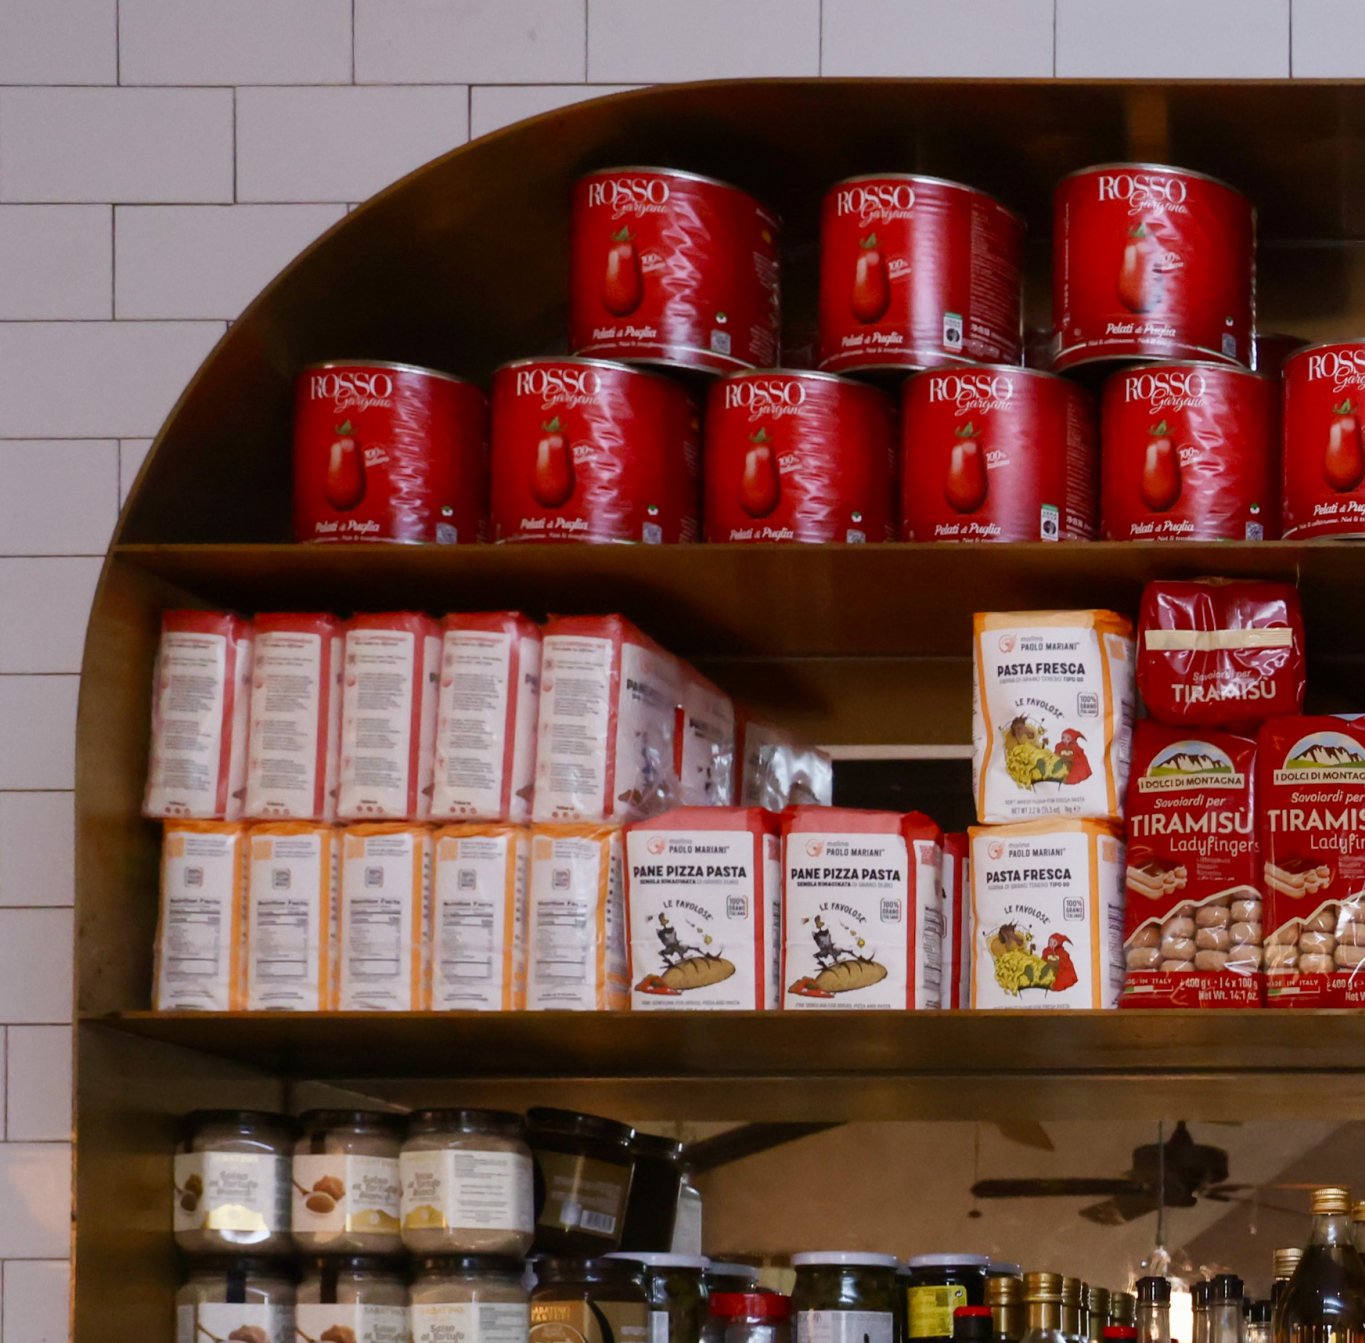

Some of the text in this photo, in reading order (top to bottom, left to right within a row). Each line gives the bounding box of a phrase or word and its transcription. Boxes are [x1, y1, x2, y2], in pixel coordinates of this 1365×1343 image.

[1098, 175, 1186, 203] ROSSO
[838, 185, 915, 215] ROSSO
[311, 372, 392, 400] ROSSO
[998, 663, 1085, 677] PASTA FRESCA
[1027, 698, 1062, 718] FAVOLOSE
[1280, 770, 1308, 782] DOLCI
[1310, 770, 1322, 780] DI
[1154, 795, 1227, 809] Savoiardi per
[1131, 806, 1254, 837] TIRAMISÙ
[695, 846, 726, 854] MARIANI
[634, 865, 746, 878] PANE PIZZA PASTA
[791, 868, 900, 881] PANE PIZZA PASTA
[987, 868, 1071, 883] PASTA FRESCA
[832, 903, 866, 923] FAVOLOSE
